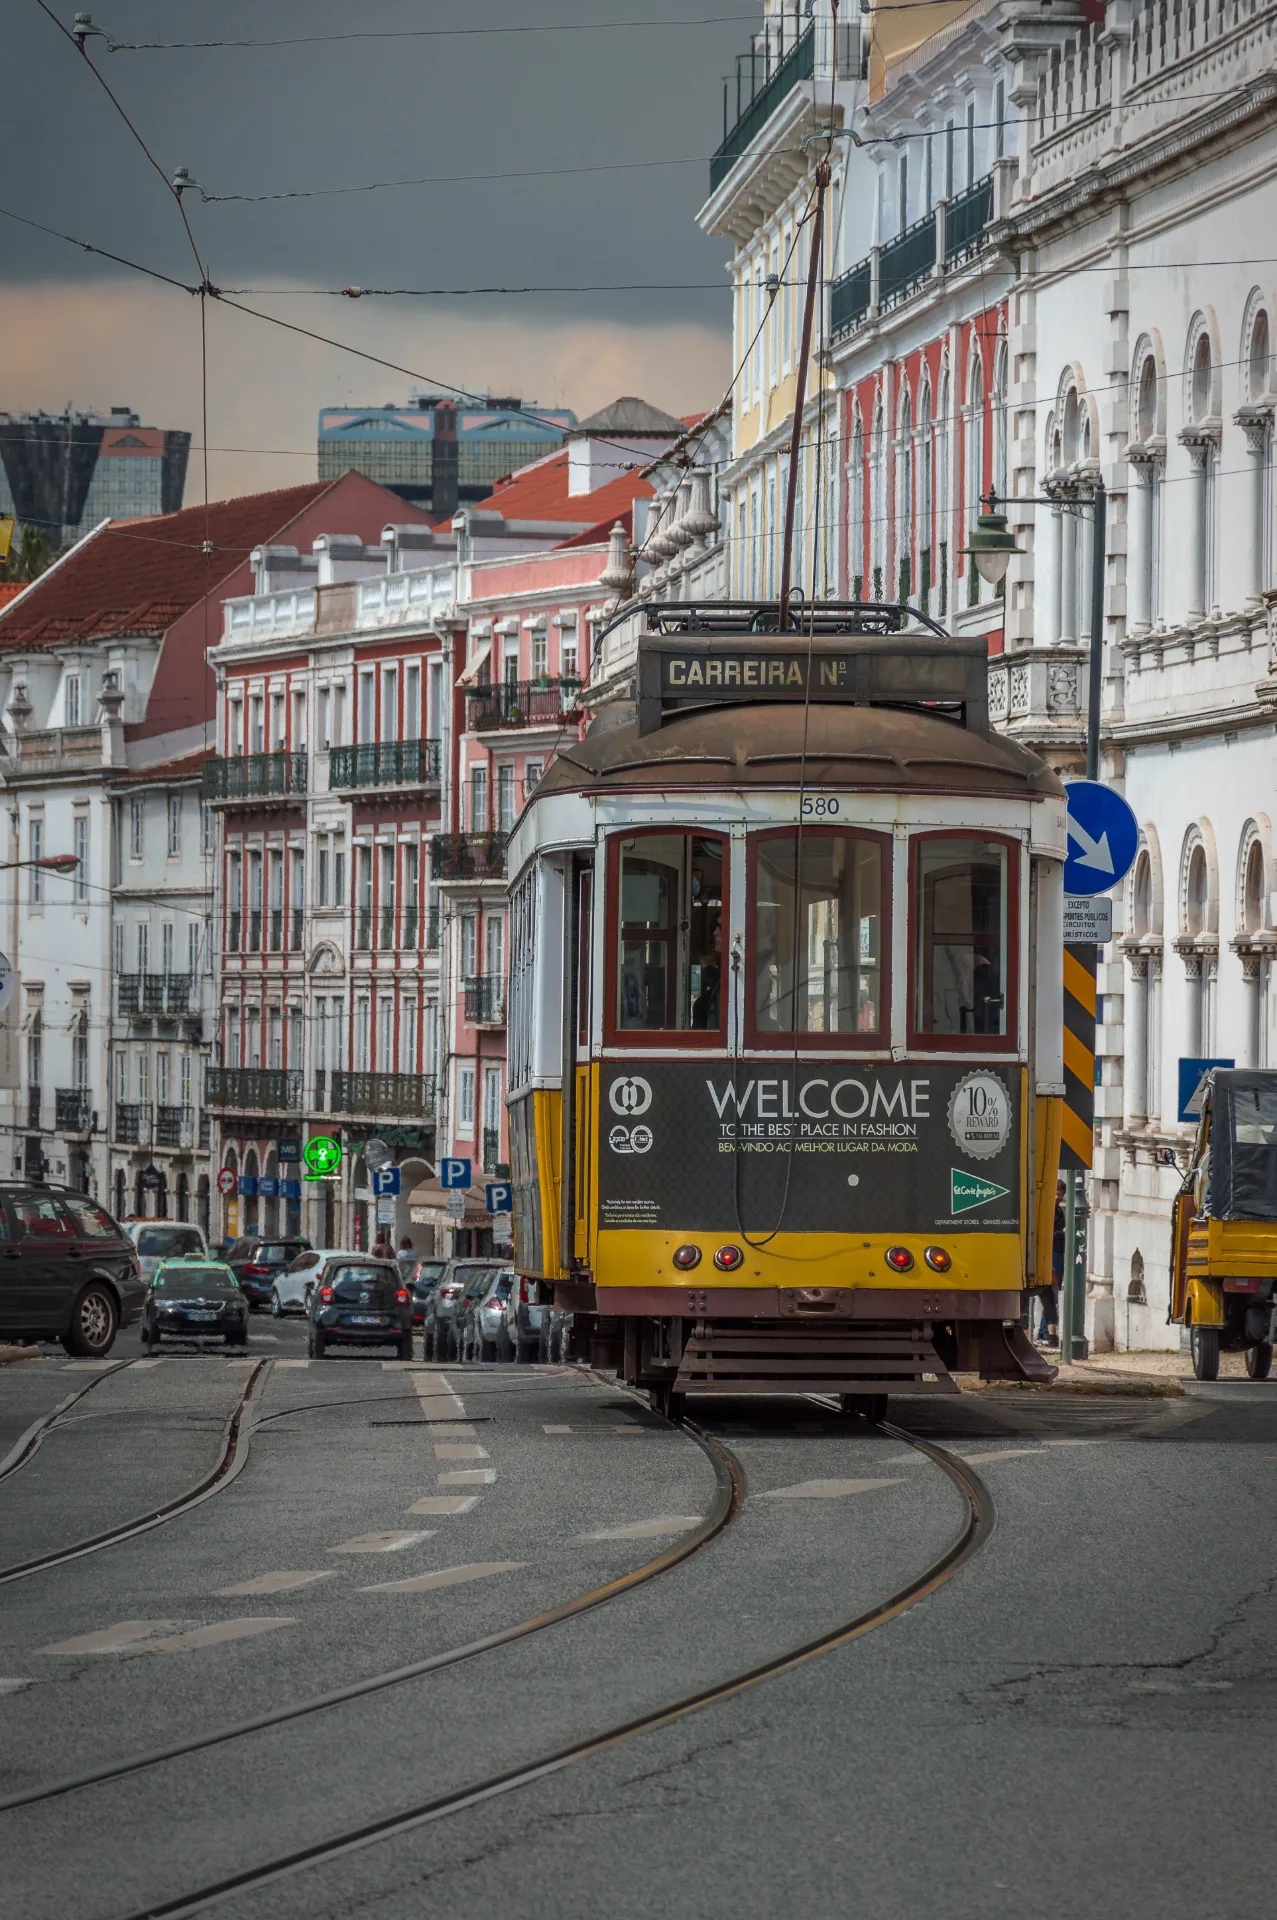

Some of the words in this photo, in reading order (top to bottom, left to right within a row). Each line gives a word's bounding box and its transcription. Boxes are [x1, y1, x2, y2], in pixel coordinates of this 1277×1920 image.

[669, 660, 804, 685] CARREIRA
[801, 797, 840, 816] 580
[1067, 901, 1090, 909] EXCEPTO
[1084, 910, 1109, 922] PÚBLICOS
[705, 1079, 930, 1119] WELCOME
[741, 1123, 765, 1136] THE
[768, 1123, 797, 1136] BEST
[801, 1123, 839, 1136] PLACE
[843, 1123, 857, 1136] IN
[860, 1123, 917, 1136] FASHION
[966, 1116, 999, 1128] REWARD
[718, 1142, 774, 1153] BEM-VINDO
[795, 1142, 835, 1153] MELHOR
[837, 1142, 869, 1153] LUGAR
[871, 1142, 886, 1152] DA
[887, 1142, 918, 1152] MODA
[378, 1170, 394, 1192] P
[447, 1160, 465, 1186] P
[491, 1186, 508, 1210] P
